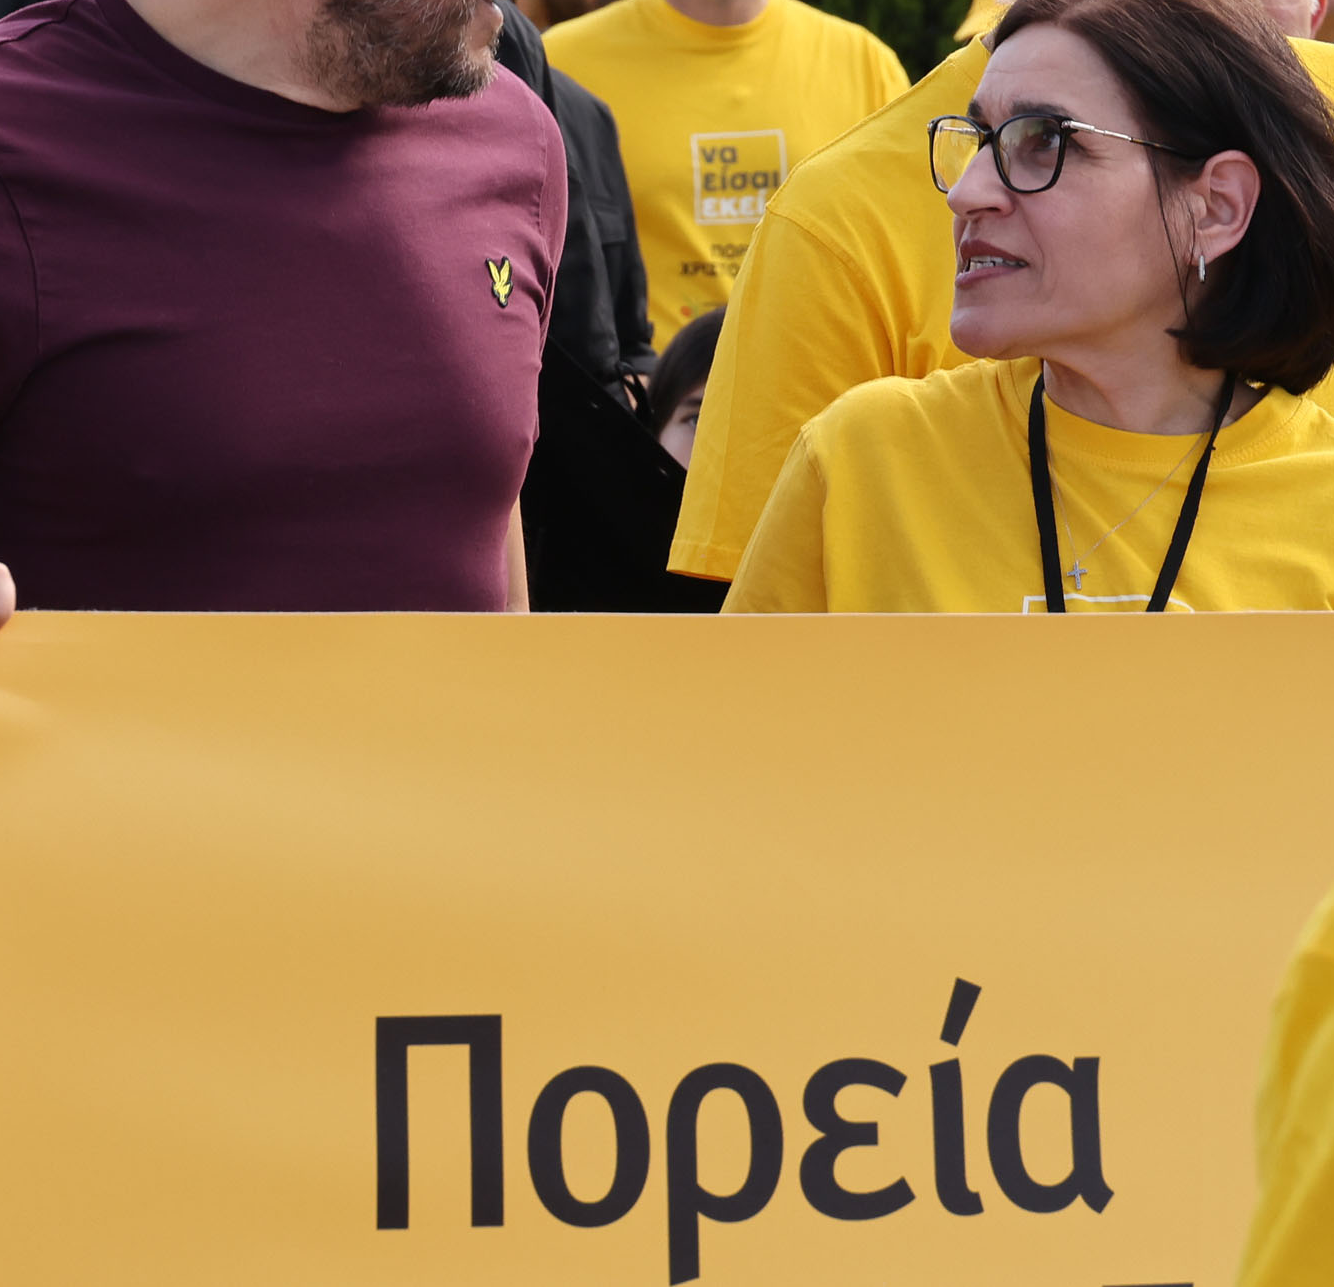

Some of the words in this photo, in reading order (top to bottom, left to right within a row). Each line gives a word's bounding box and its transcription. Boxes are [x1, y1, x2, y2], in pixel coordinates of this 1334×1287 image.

[701, 146, 737, 163] να
[704, 166, 780, 191] είσαι
[375, 976, 1115, 1287] Πορεία
